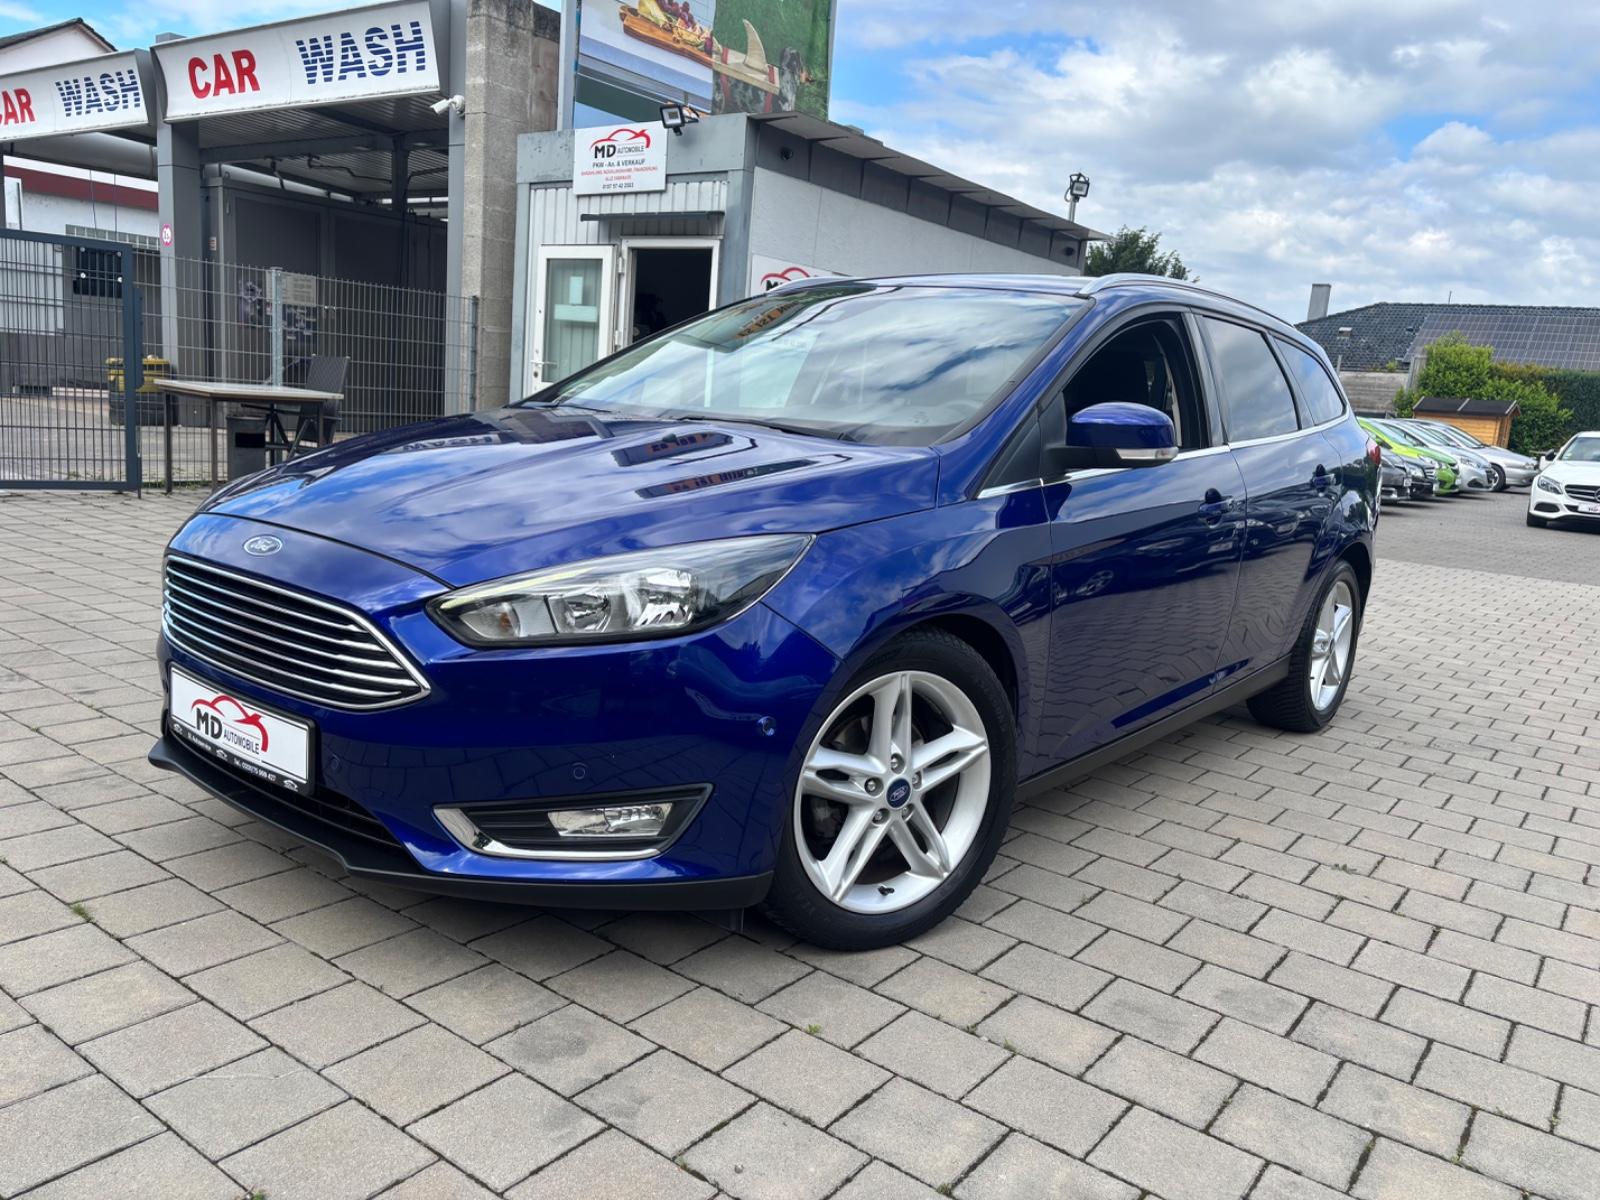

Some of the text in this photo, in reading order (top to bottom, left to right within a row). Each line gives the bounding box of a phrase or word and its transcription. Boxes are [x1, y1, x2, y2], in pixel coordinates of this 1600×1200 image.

[188, 21, 427, 99] CAR WASH
[0, 69, 140, 125] AR WASH
[594, 144, 645, 159] MD AUTOMOBILE
[196, 708, 222, 740] MD
[223, 729, 260, 755] AUTOMOBILE
